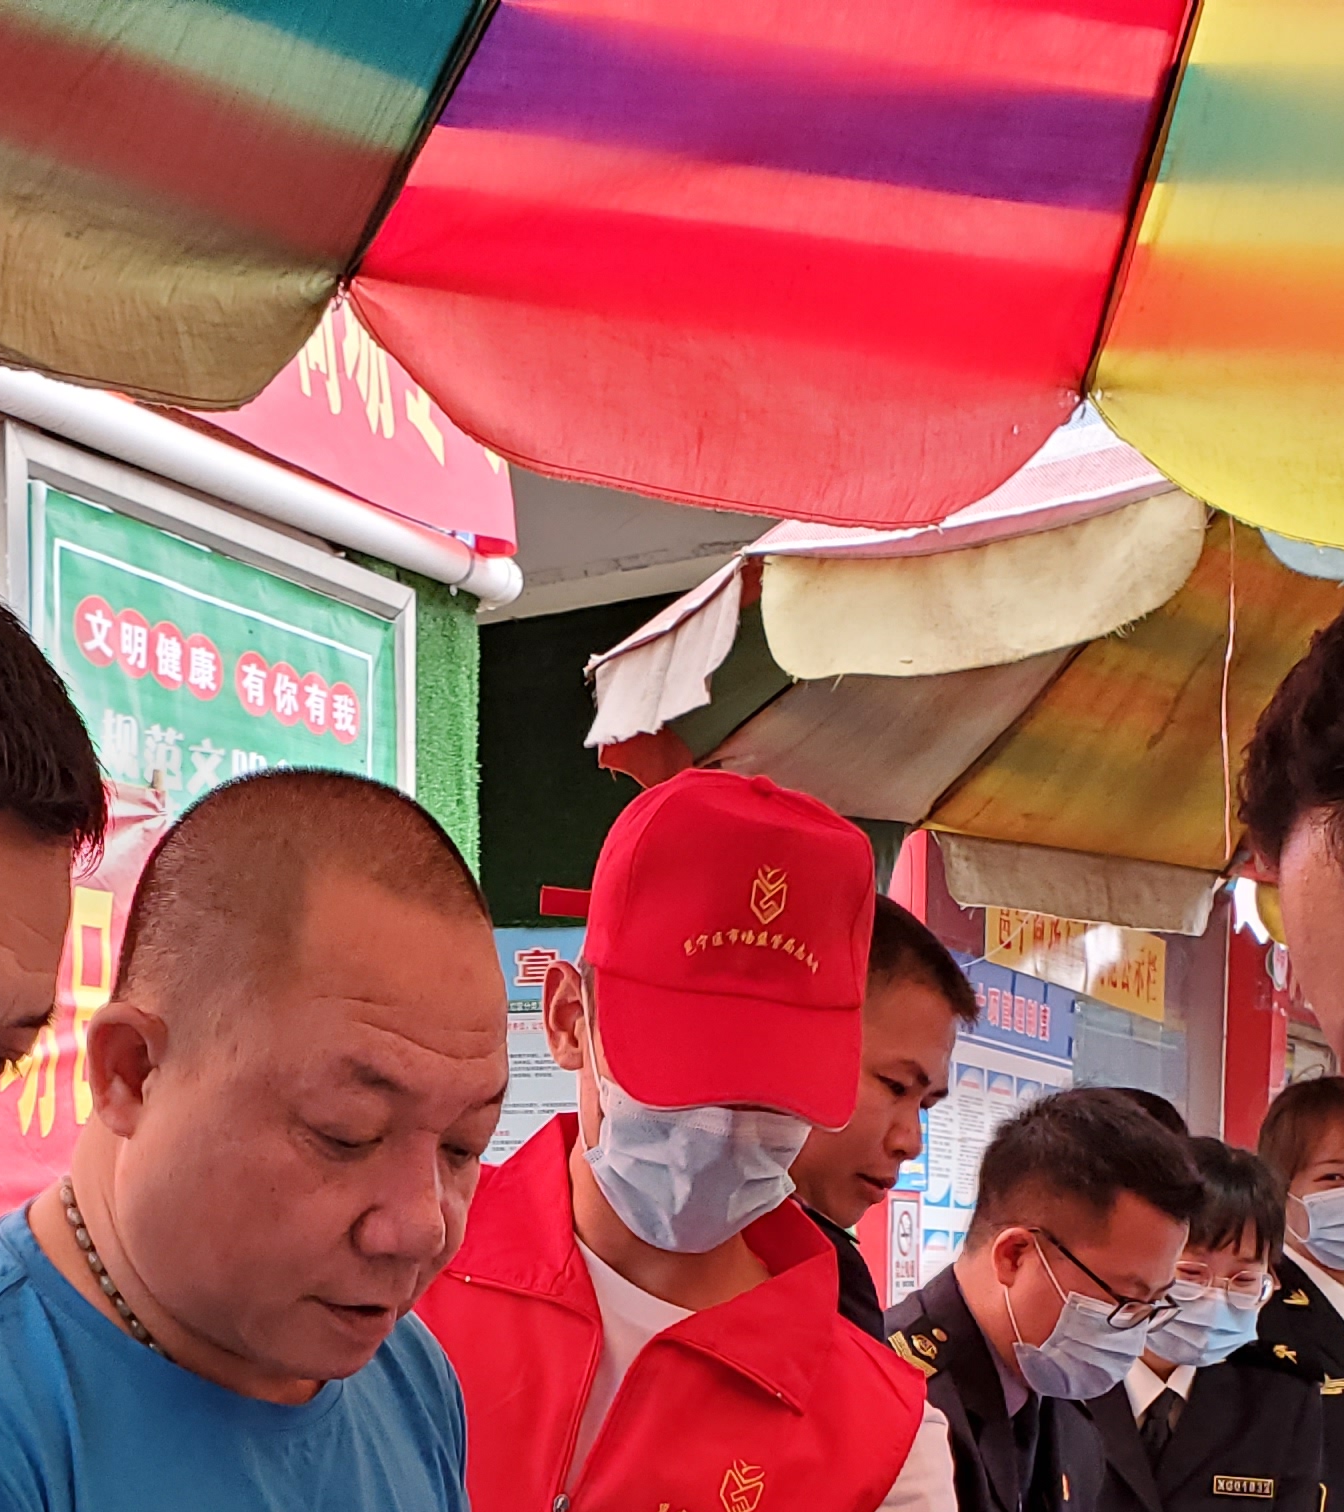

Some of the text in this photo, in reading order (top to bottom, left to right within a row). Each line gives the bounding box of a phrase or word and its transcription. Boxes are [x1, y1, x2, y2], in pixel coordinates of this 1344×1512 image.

[83, 609, 358, 734] 文明健康 有你有我
